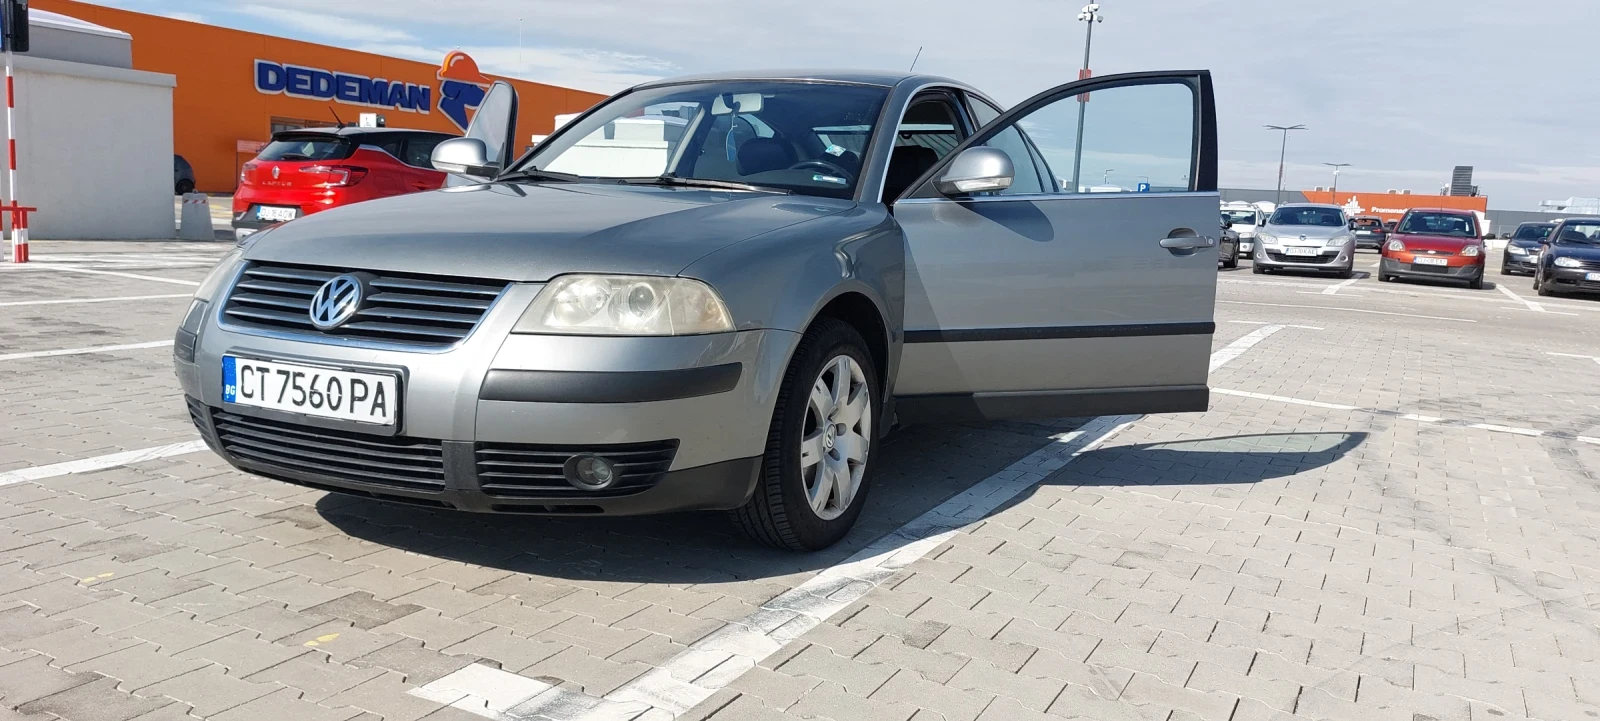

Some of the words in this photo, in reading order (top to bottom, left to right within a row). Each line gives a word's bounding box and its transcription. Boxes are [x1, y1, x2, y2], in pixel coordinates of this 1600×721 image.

[255, 60, 431, 113] DEDEMAN
[1139, 184, 1147, 192] P
[1371, 206, 1409, 214] Promenad
[225, 384, 236, 396] BG
[240, 364, 270, 402] CT
[276, 369, 343, 412] 7560
[349, 378, 387, 418] PA
